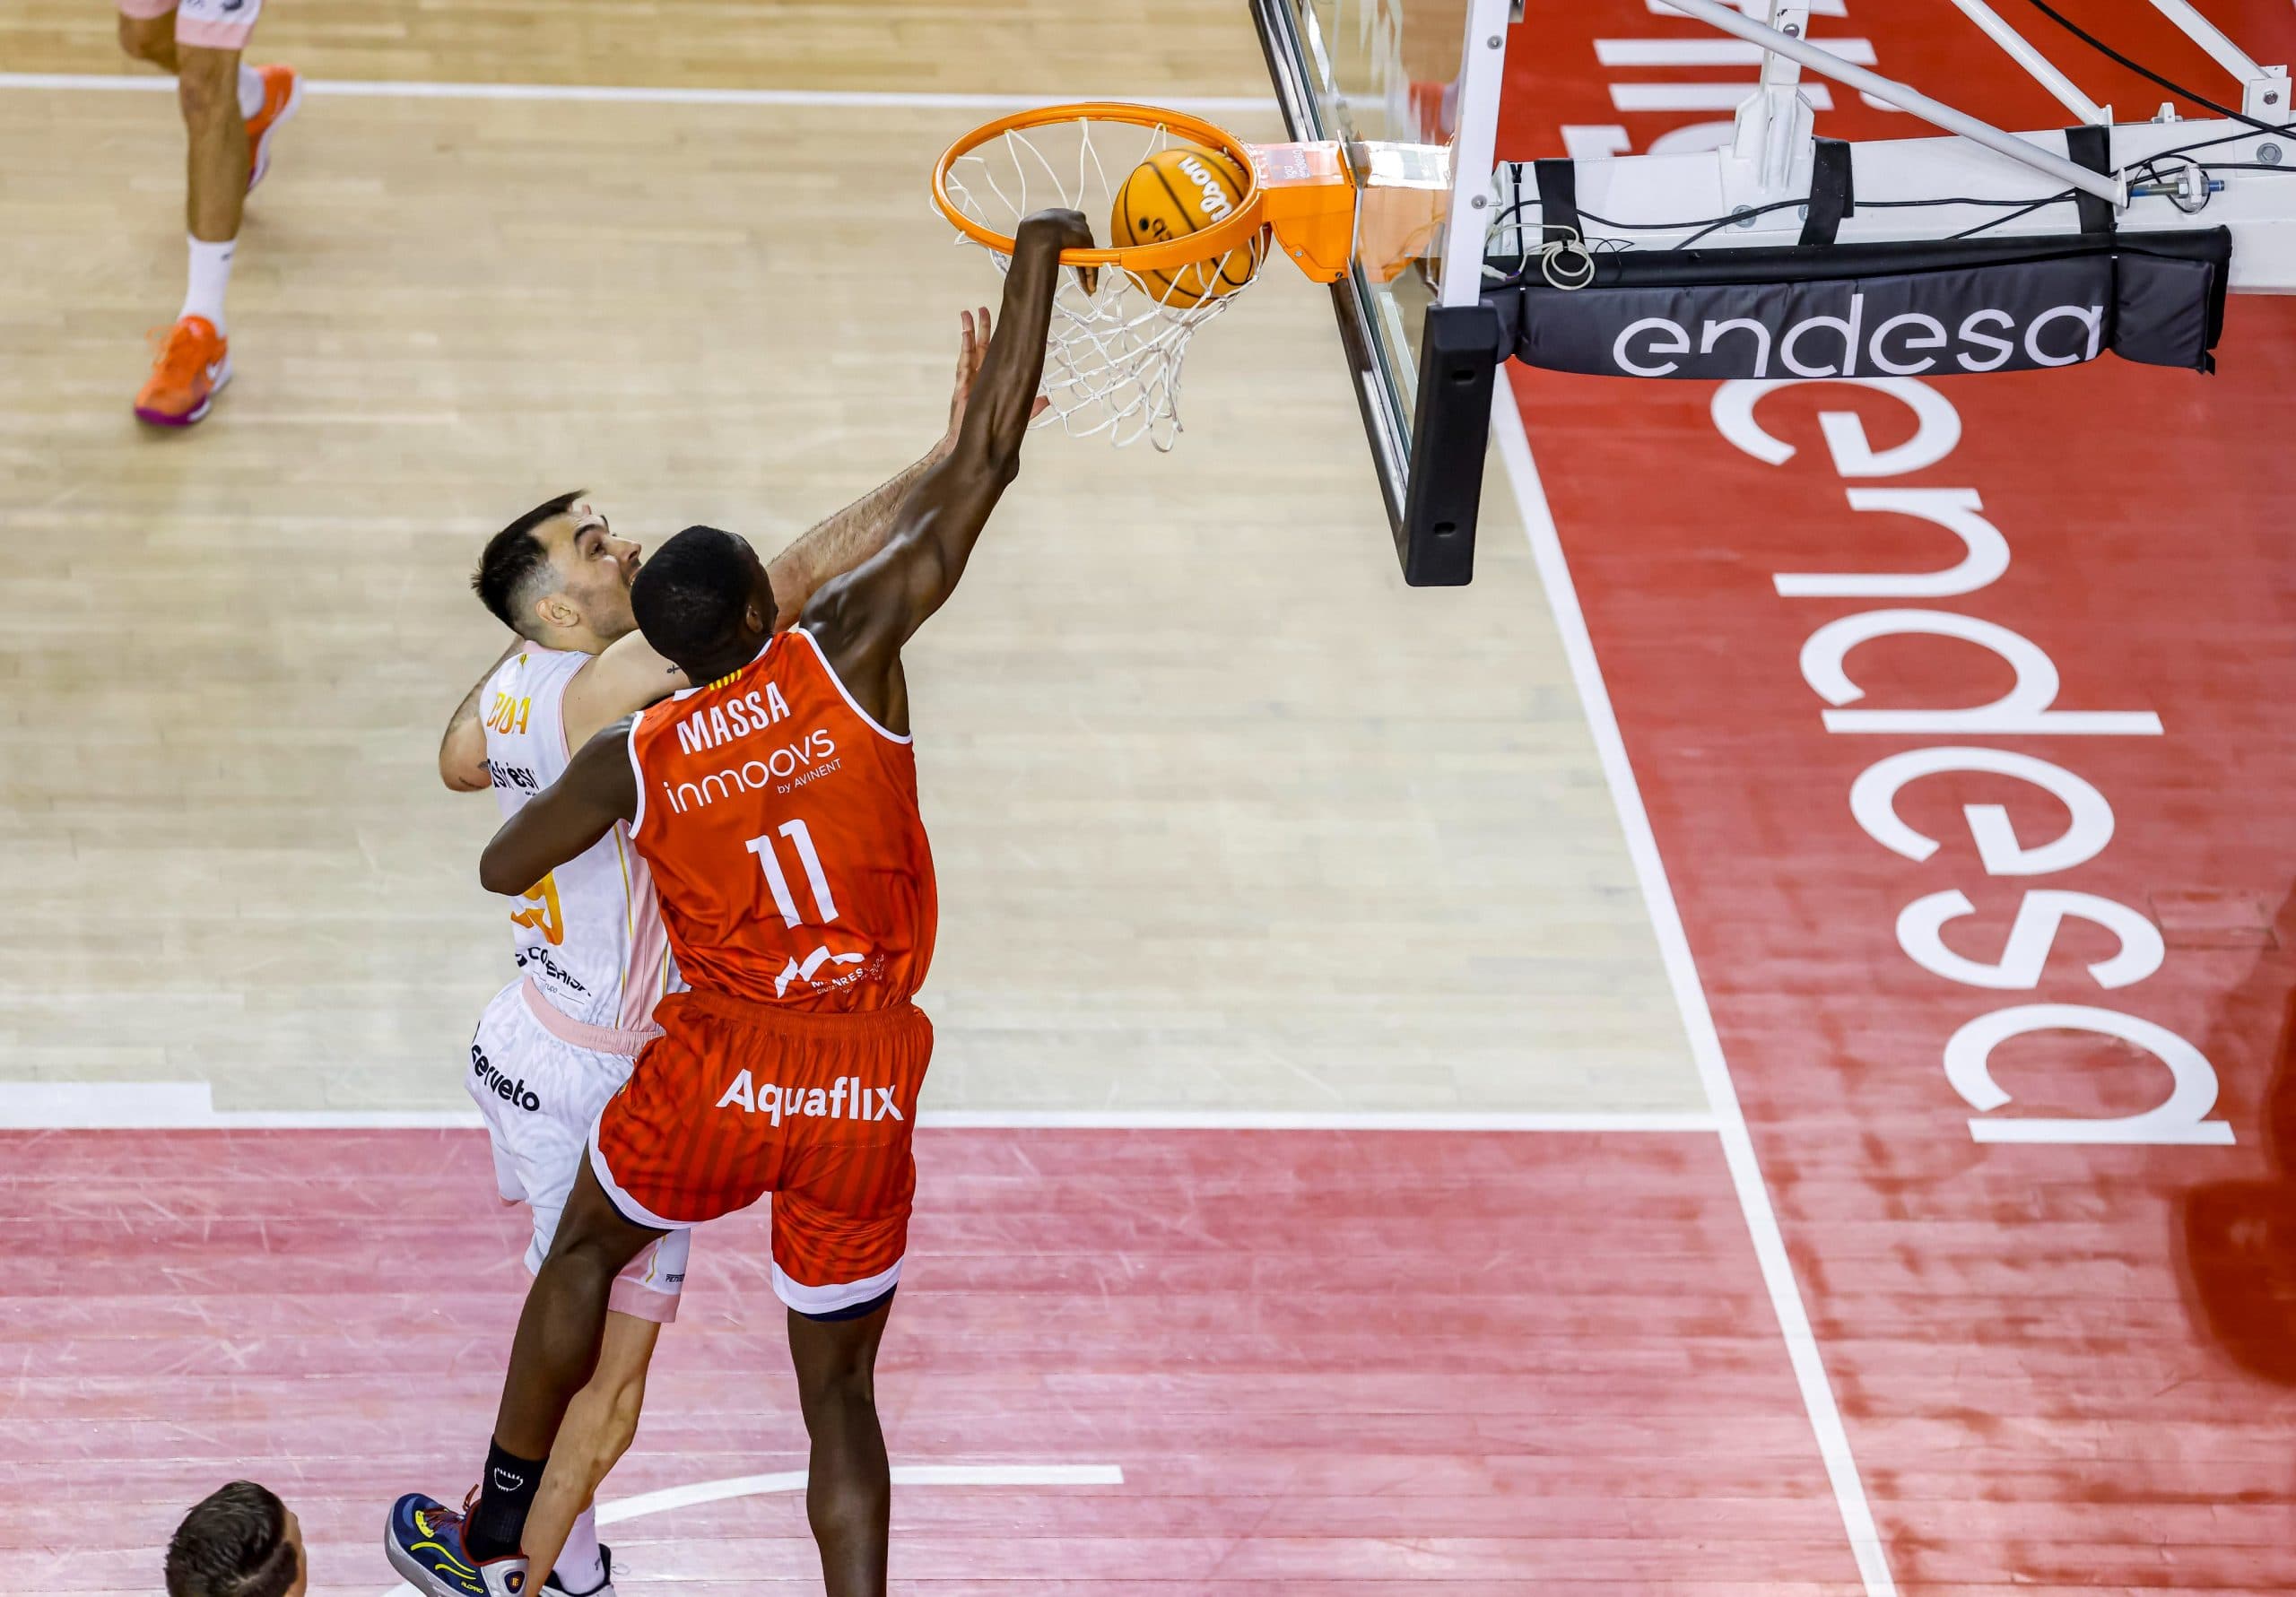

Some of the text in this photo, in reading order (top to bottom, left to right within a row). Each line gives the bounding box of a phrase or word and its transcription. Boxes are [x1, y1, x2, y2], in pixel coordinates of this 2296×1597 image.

[1612, 293, 2104, 378] endesa
[676, 681, 791, 755] MASSA
[663, 729, 835, 813] inmoovs
[777, 758, 842, 794] by AVINENT
[1709, 378, 2237, 1145] endesa
[744, 819, 839, 929] 11
[715, 1068, 905, 1128] Aquaflix
